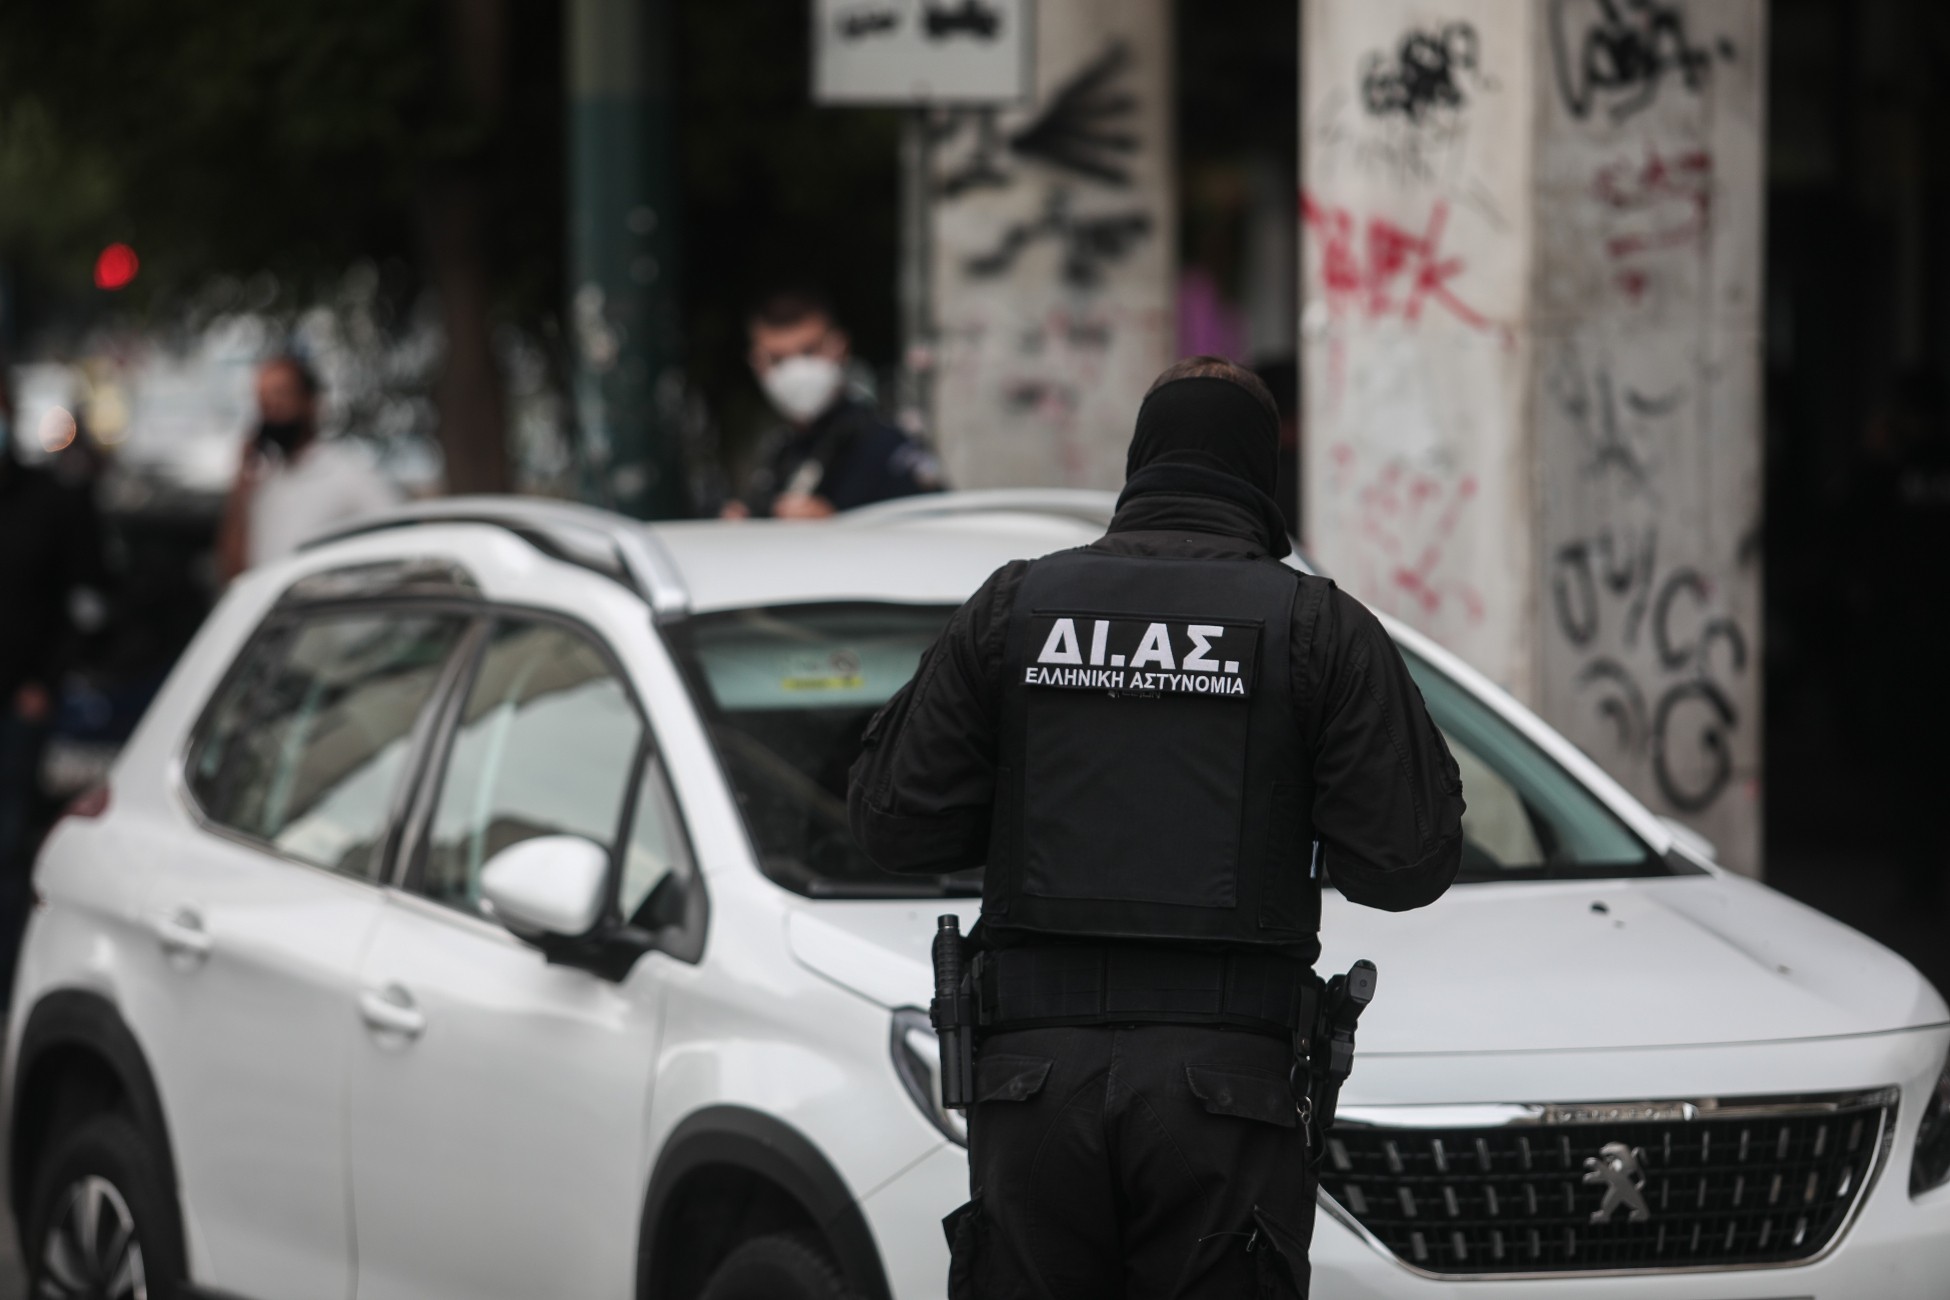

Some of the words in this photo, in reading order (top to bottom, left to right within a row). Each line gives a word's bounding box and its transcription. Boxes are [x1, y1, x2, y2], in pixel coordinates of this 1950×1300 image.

[1037, 618, 1240, 673] ΔΙ.ΑΣ.
[1025, 667, 1124, 688] ΕΛΛΗΝΙΚΗ
[1130, 673, 1245, 694] ΑΣΤΥΝΟΜΙΑ
